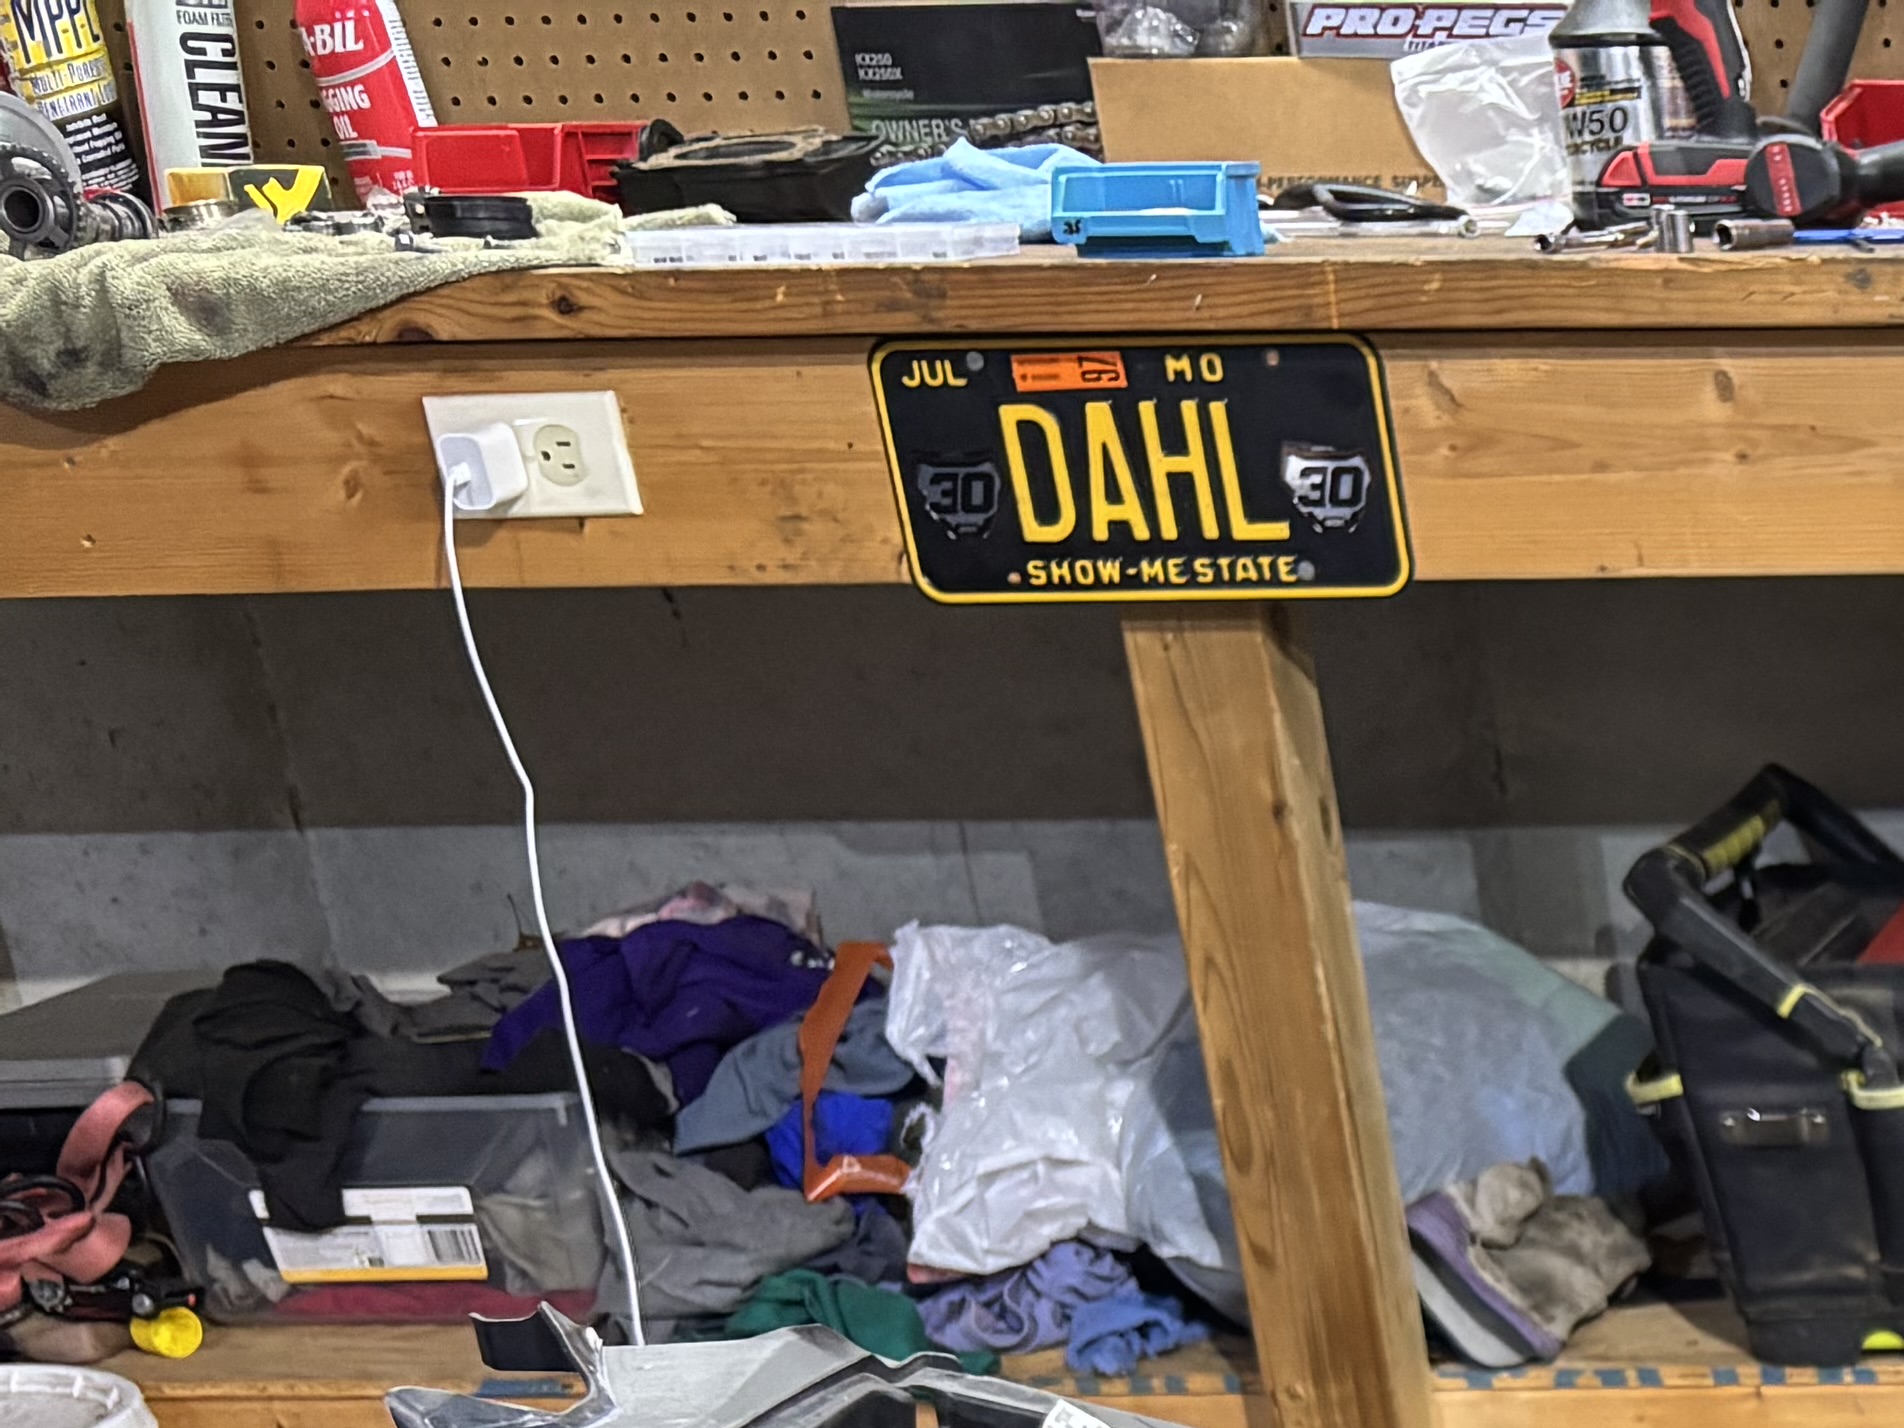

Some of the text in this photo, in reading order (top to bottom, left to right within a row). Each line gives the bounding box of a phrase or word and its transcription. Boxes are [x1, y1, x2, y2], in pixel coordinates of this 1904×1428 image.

[176, 10, 208, 26] FOAM
[179, 31, 254, 167] CLEAN
[902, 360, 968, 387] JUL
[999, 400, 1291, 542] DAHL
[1298, 466, 1369, 509] 30
[928, 472, 997, 515] 30
[1027, 556, 1300, 587] SHOW-ME STATE
